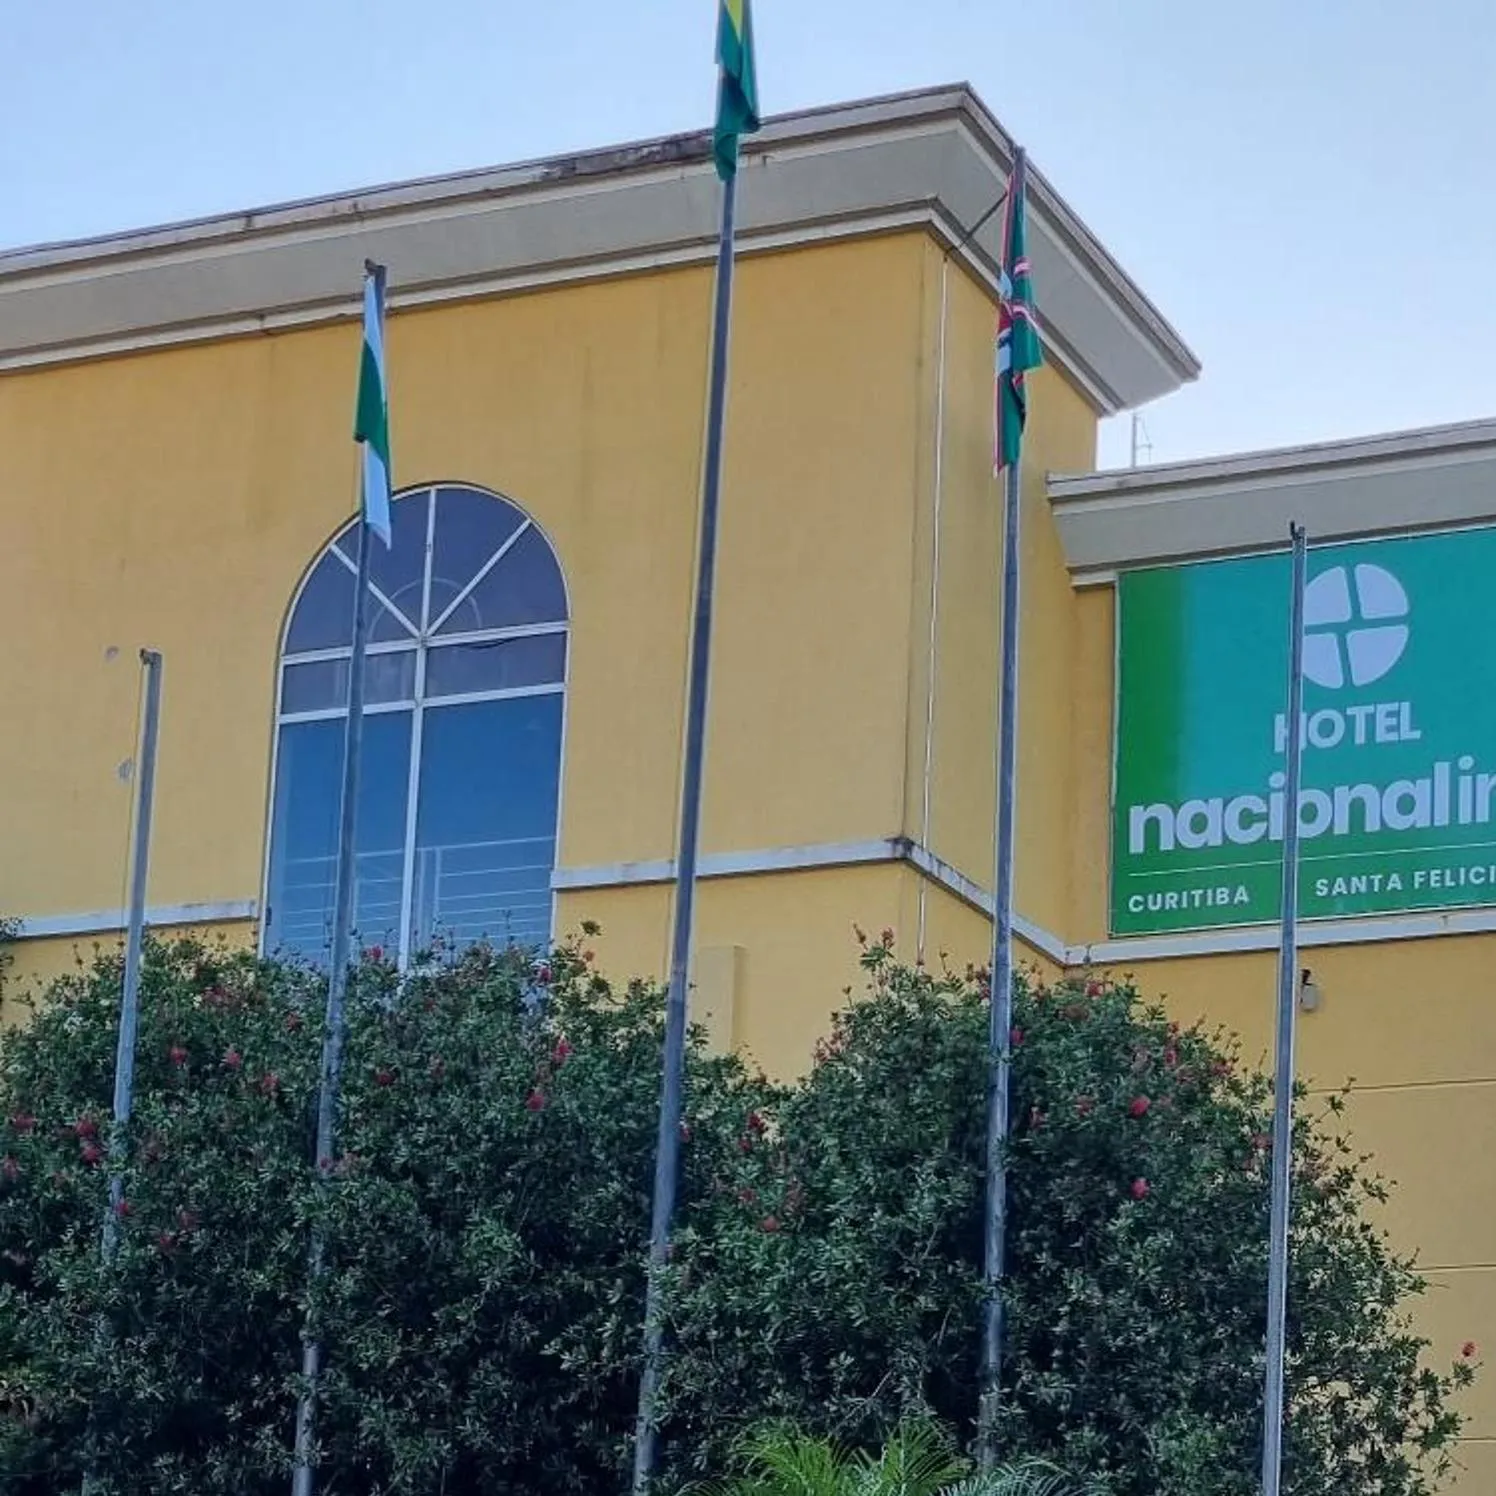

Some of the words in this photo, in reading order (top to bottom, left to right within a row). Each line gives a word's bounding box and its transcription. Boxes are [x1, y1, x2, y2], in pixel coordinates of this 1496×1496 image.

[1274, 702, 1421, 752] HOTEL
[1128, 885, 1250, 913] CURITIBA
[1315, 872, 1403, 898] SANTA
